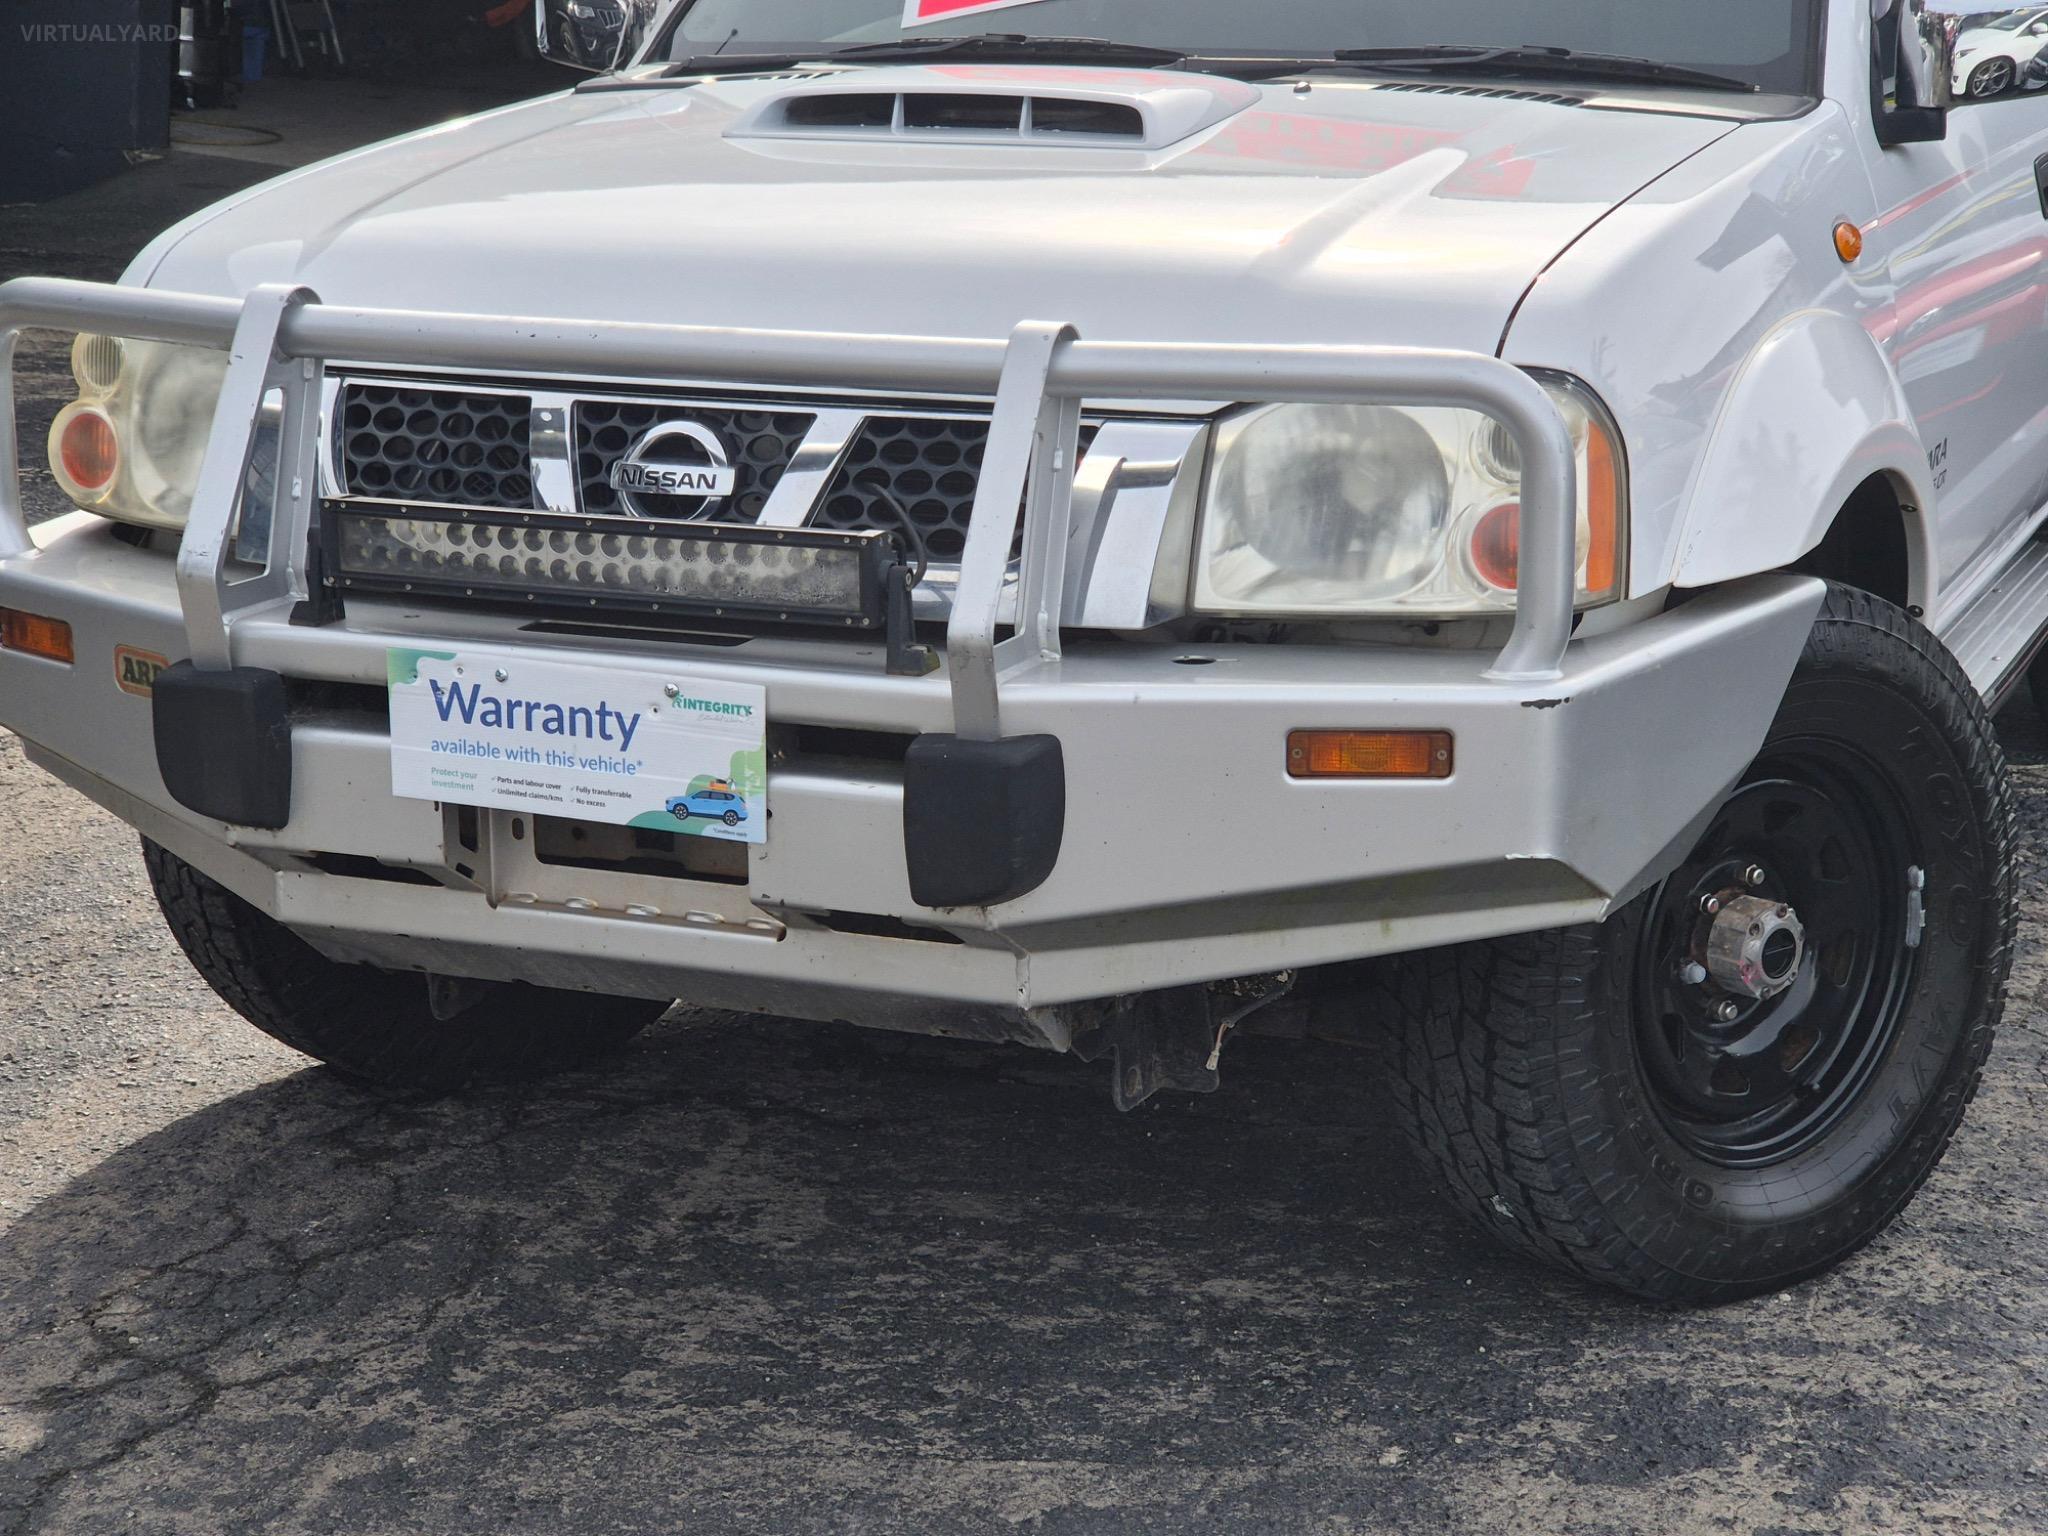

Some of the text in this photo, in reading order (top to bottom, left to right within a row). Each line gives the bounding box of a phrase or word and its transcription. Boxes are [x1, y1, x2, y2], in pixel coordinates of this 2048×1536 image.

[620, 468, 718, 490] NISSAN
[683, 697, 753, 717] INTEGRITY
[428, 678, 641, 753] Warranty
[430, 738, 501, 759] available
[504, 745, 541, 764] with
[545, 749, 576, 769] this
[430, 767, 478, 780] Protect your
[430, 778, 475, 792] investment
[496, 776, 562, 791] Parts and labour cover
[575, 785, 591, 795] Fully
[496, 788, 564, 803] Unlimited claims/kms
[575, 798, 607, 809] No excess
